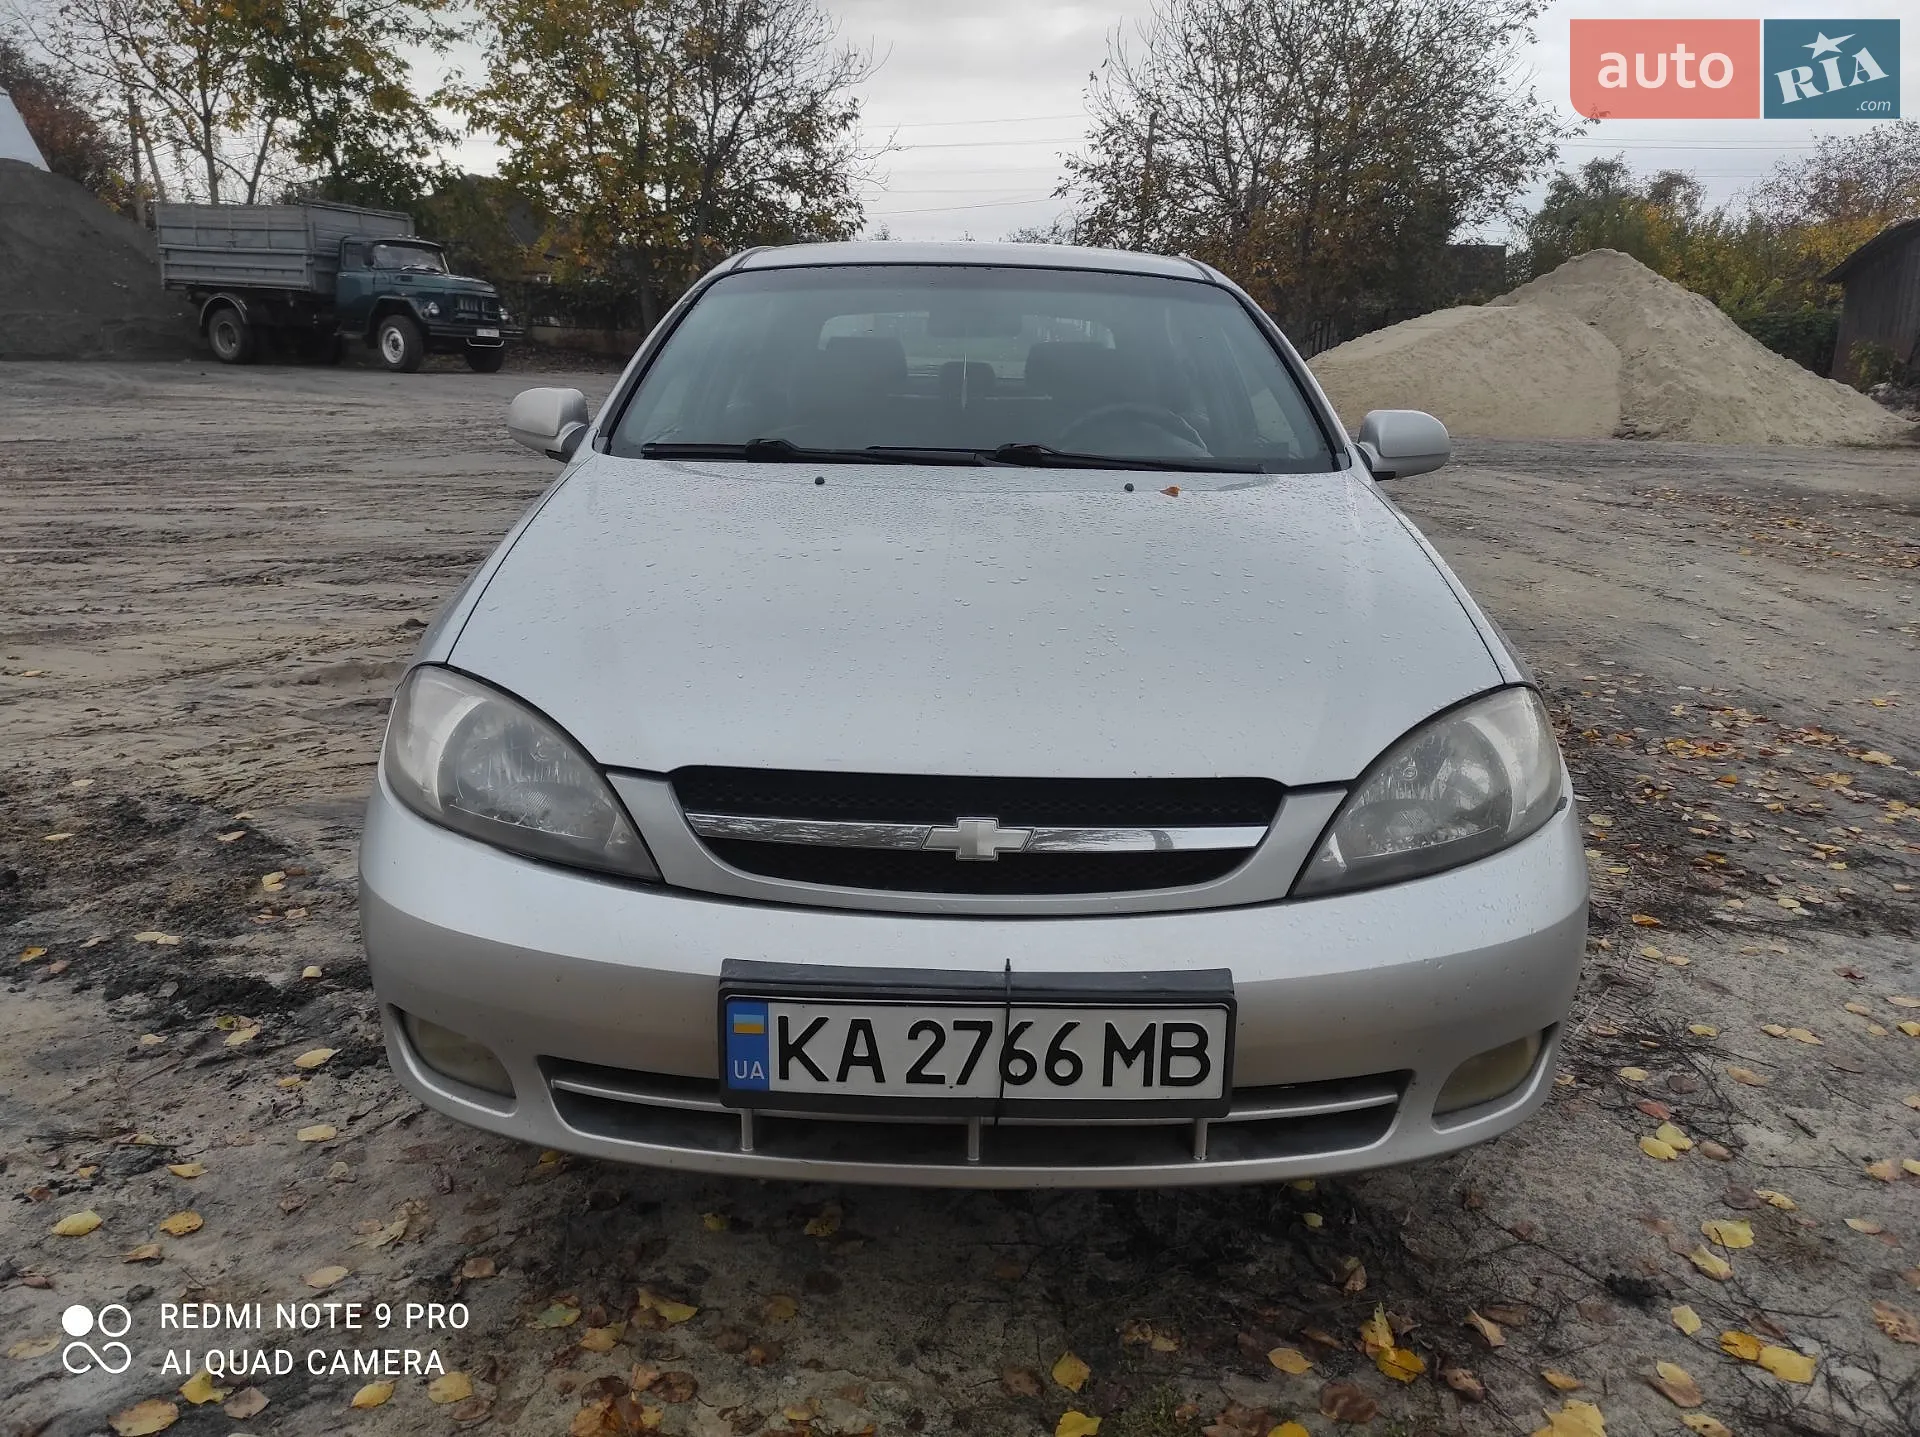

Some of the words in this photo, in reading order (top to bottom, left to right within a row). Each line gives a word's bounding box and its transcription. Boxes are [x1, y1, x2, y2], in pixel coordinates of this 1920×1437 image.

[733, 1060, 765, 1080] UA
[777, 1014, 886, 1083] KA
[905, 1019, 1083, 1087] 2766
[1102, 1021, 1211, 1087] MB
